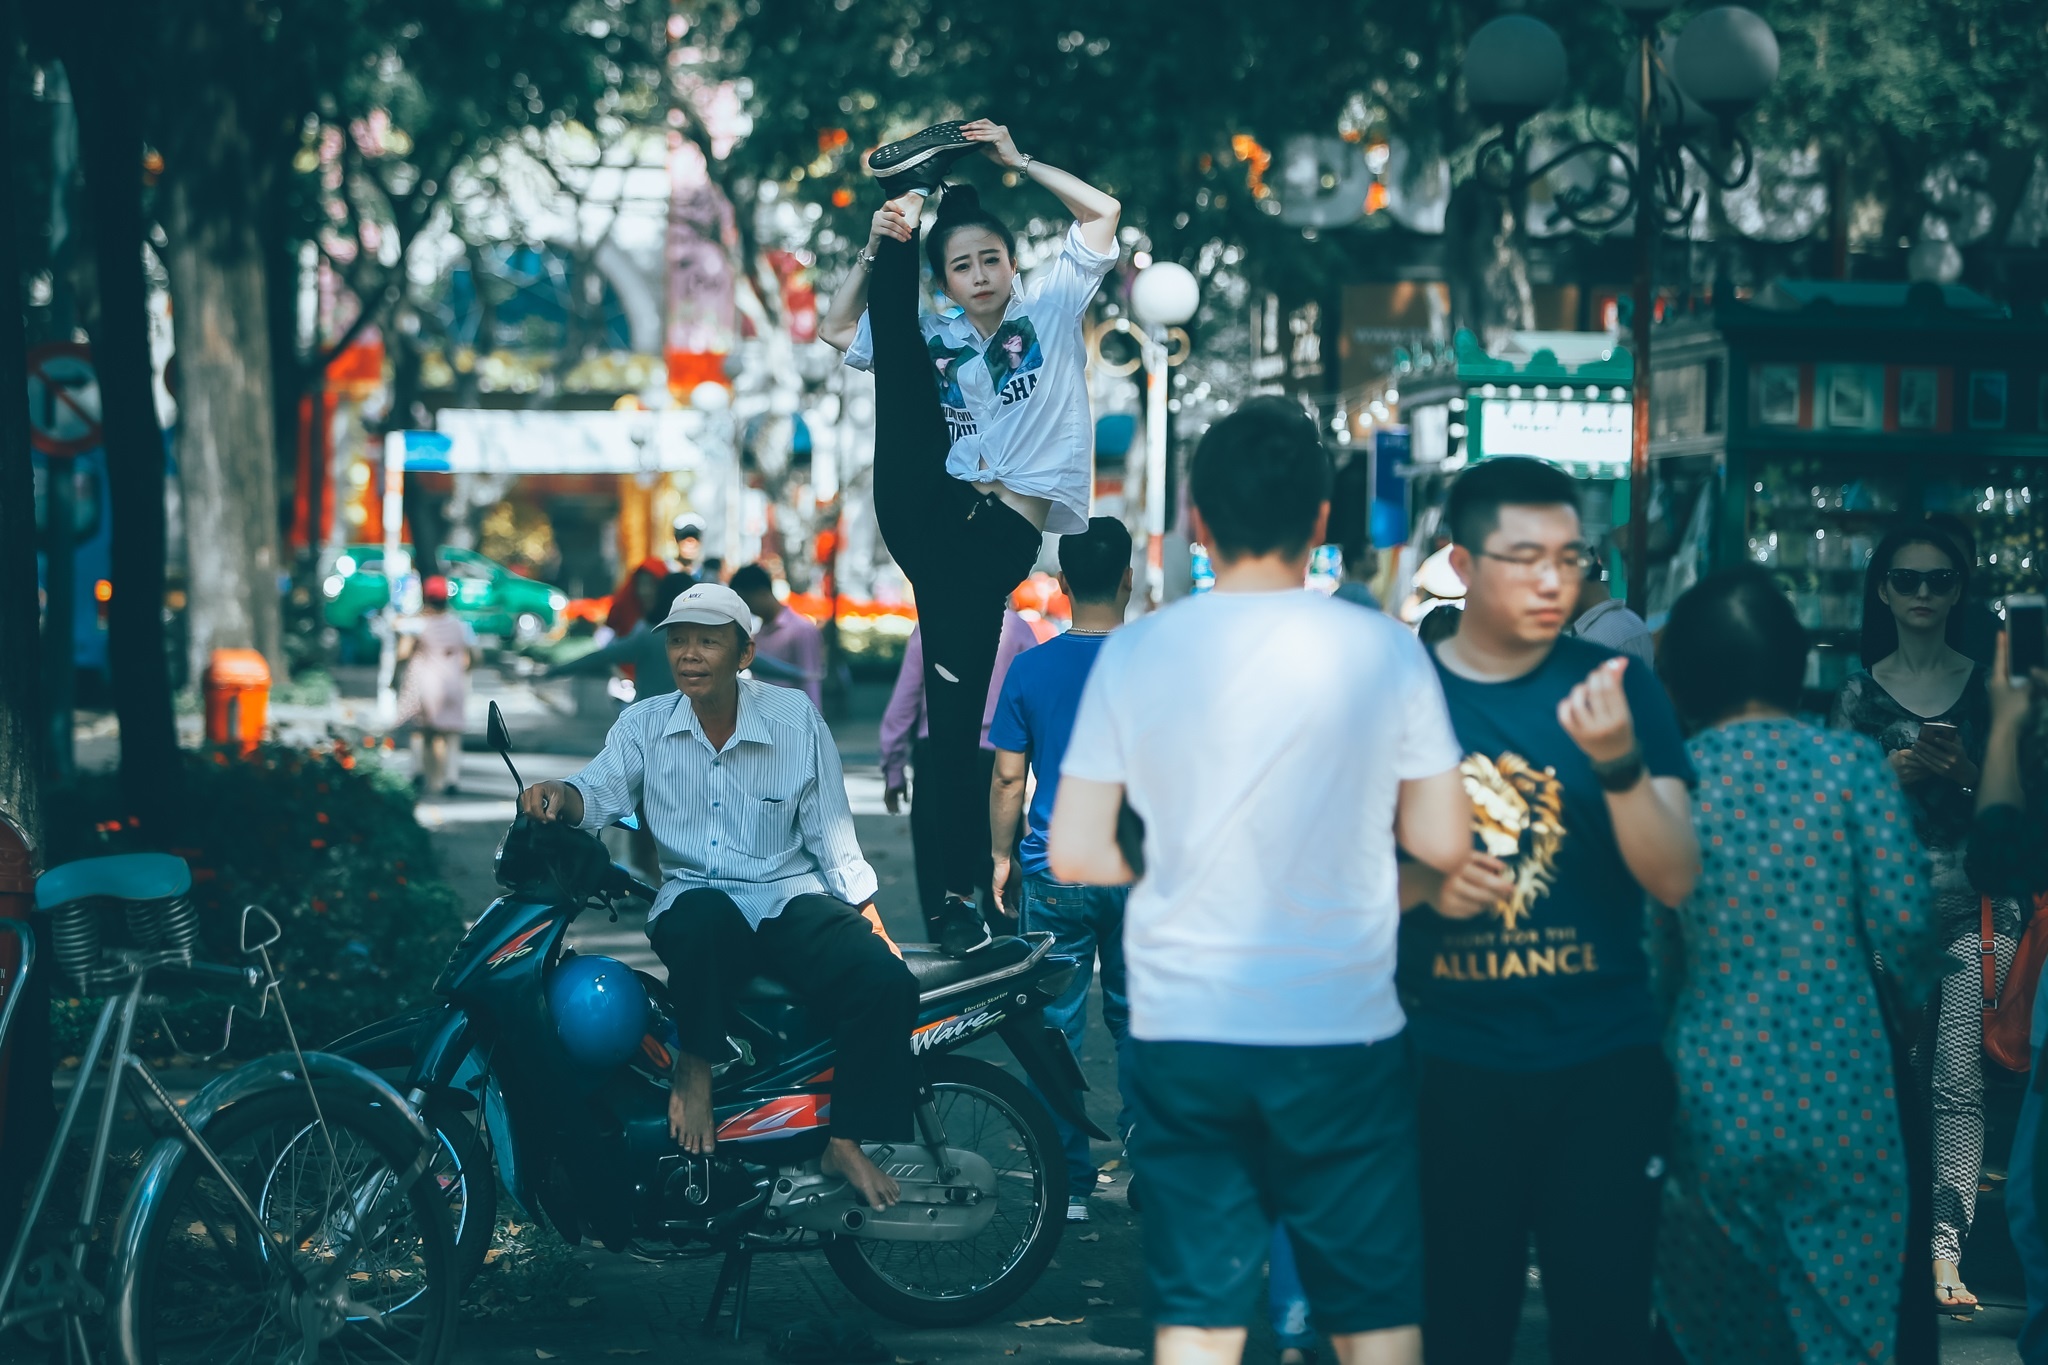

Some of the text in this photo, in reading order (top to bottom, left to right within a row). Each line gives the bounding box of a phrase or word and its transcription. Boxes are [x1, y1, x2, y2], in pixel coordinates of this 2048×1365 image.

[957, 411, 975, 421] EVIL
[1501, 928, 1539, 945] FOR
[1432, 942, 1599, 981] ALLIANCE
[964, 991, 1009, 1013] Electric Starter
[910, 1010, 1002, 1056] Wave
